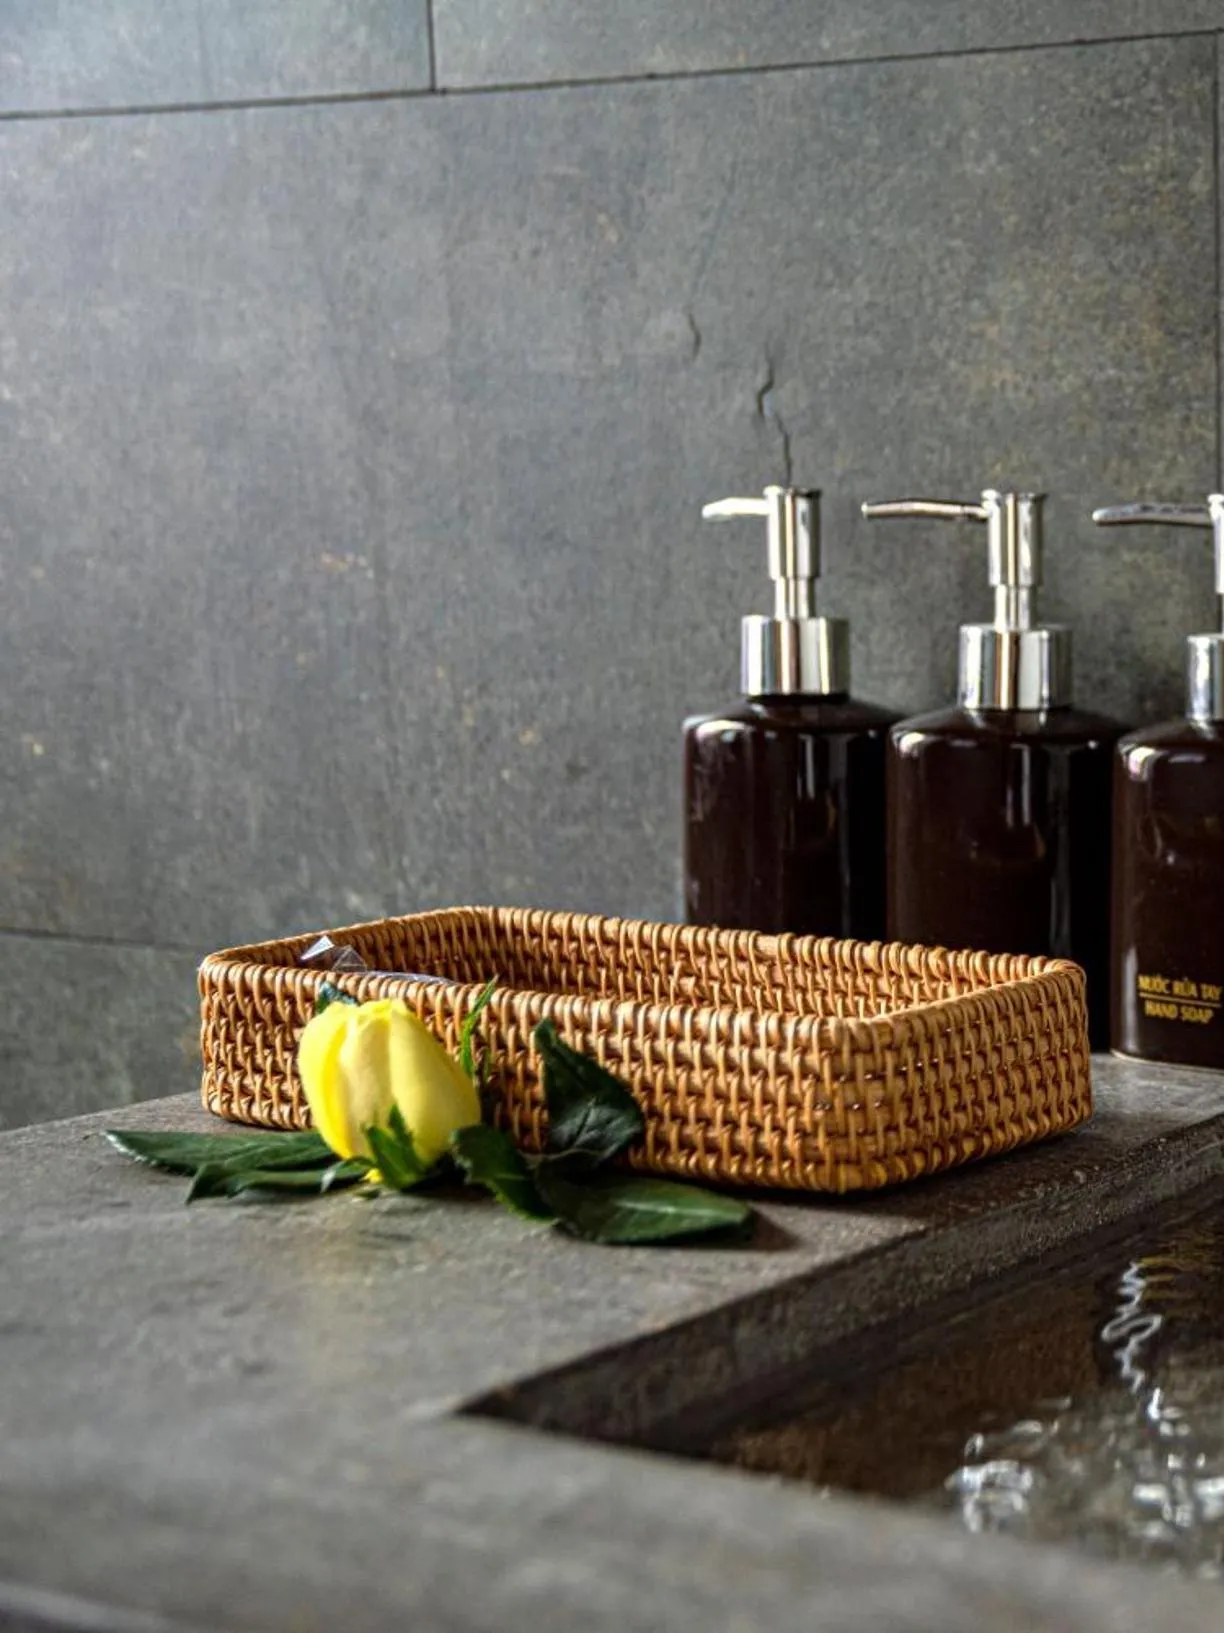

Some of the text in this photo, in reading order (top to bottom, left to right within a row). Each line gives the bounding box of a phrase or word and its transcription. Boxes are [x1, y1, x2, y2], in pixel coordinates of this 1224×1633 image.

[1200, 983, 1223, 1001] TAY
[1145, 1000, 1214, 1023] HAND SOAP
